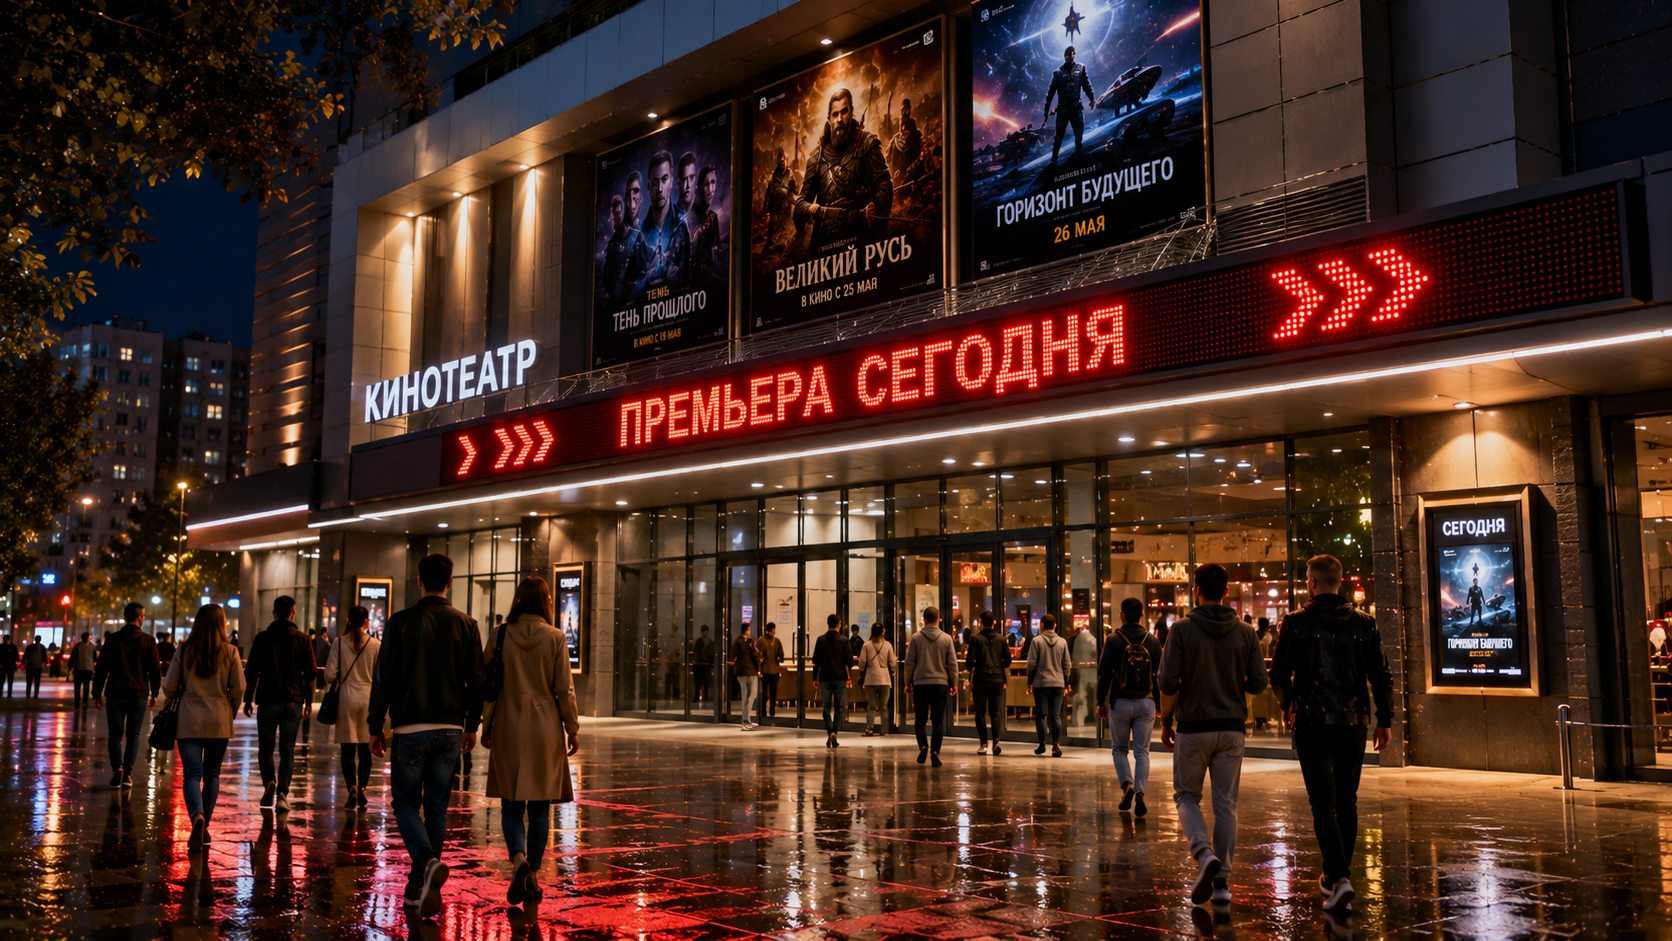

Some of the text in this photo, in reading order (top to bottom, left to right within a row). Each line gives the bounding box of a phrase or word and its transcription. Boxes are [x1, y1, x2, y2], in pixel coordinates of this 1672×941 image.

[997, 156, 1174, 228] ГОРИЗОНТ БУДУЩЕГО
[1053, 214, 1106, 244] 26 МАЯ
[775, 234, 912, 294] ВЕЛИКИЙ РУСЬ
[801, 277, 878, 308] В КИНО С 25 МАЯ
[613, 308, 640, 332] ТЕНЬ
[364, 339, 537, 424] КИНОТЕАТР
[619, 304, 1126, 449] ПРЕМЬЕРА СЕГОДНЯ
[1442, 517, 1506, 537] СЕГОДНЯ
